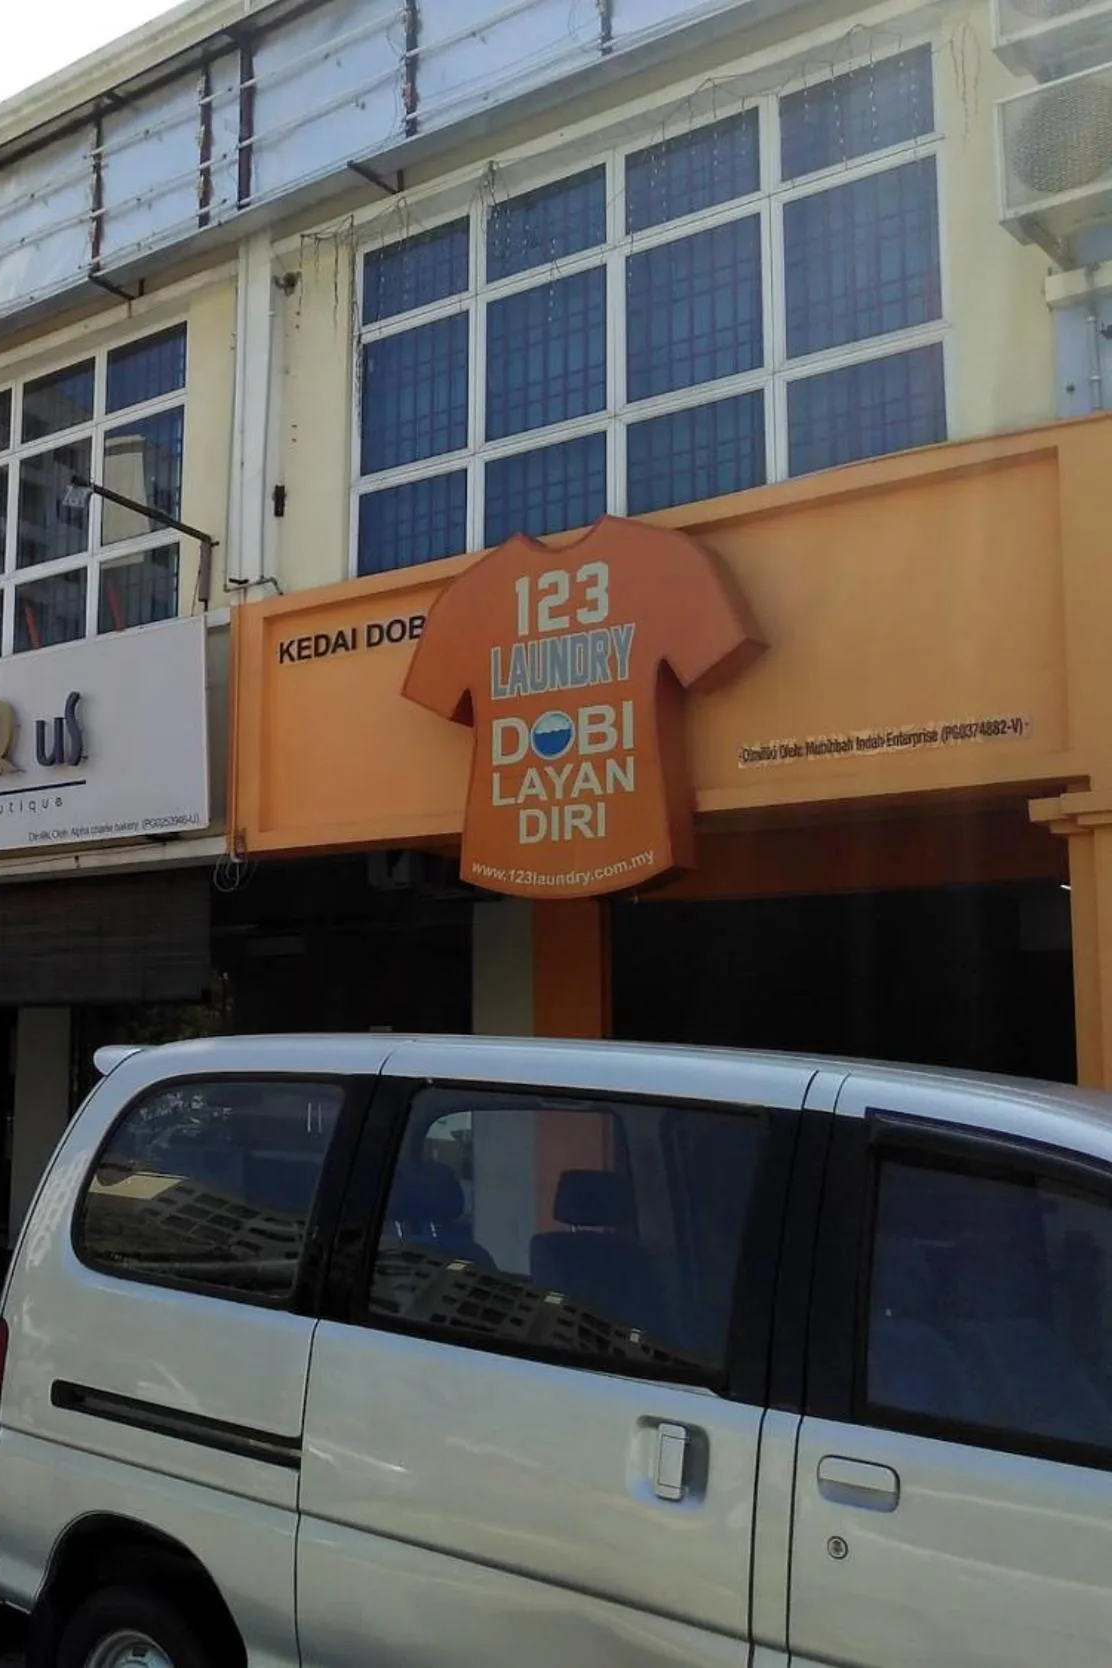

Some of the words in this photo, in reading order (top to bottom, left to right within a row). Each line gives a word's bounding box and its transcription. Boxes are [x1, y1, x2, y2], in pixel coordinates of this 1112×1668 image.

[515, 561, 610, 636] 123
[279, 628, 357, 664] KEDAI
[491, 622, 636, 700] LAUNDRY
[492, 700, 636, 767] DOBI
[886, 728, 938, 748] Enterprise
[492, 756, 636, 806] LAYAN
[519, 801, 606, 845] DIRI
[471, 847, 656, 887] www.123laundry.com.my
